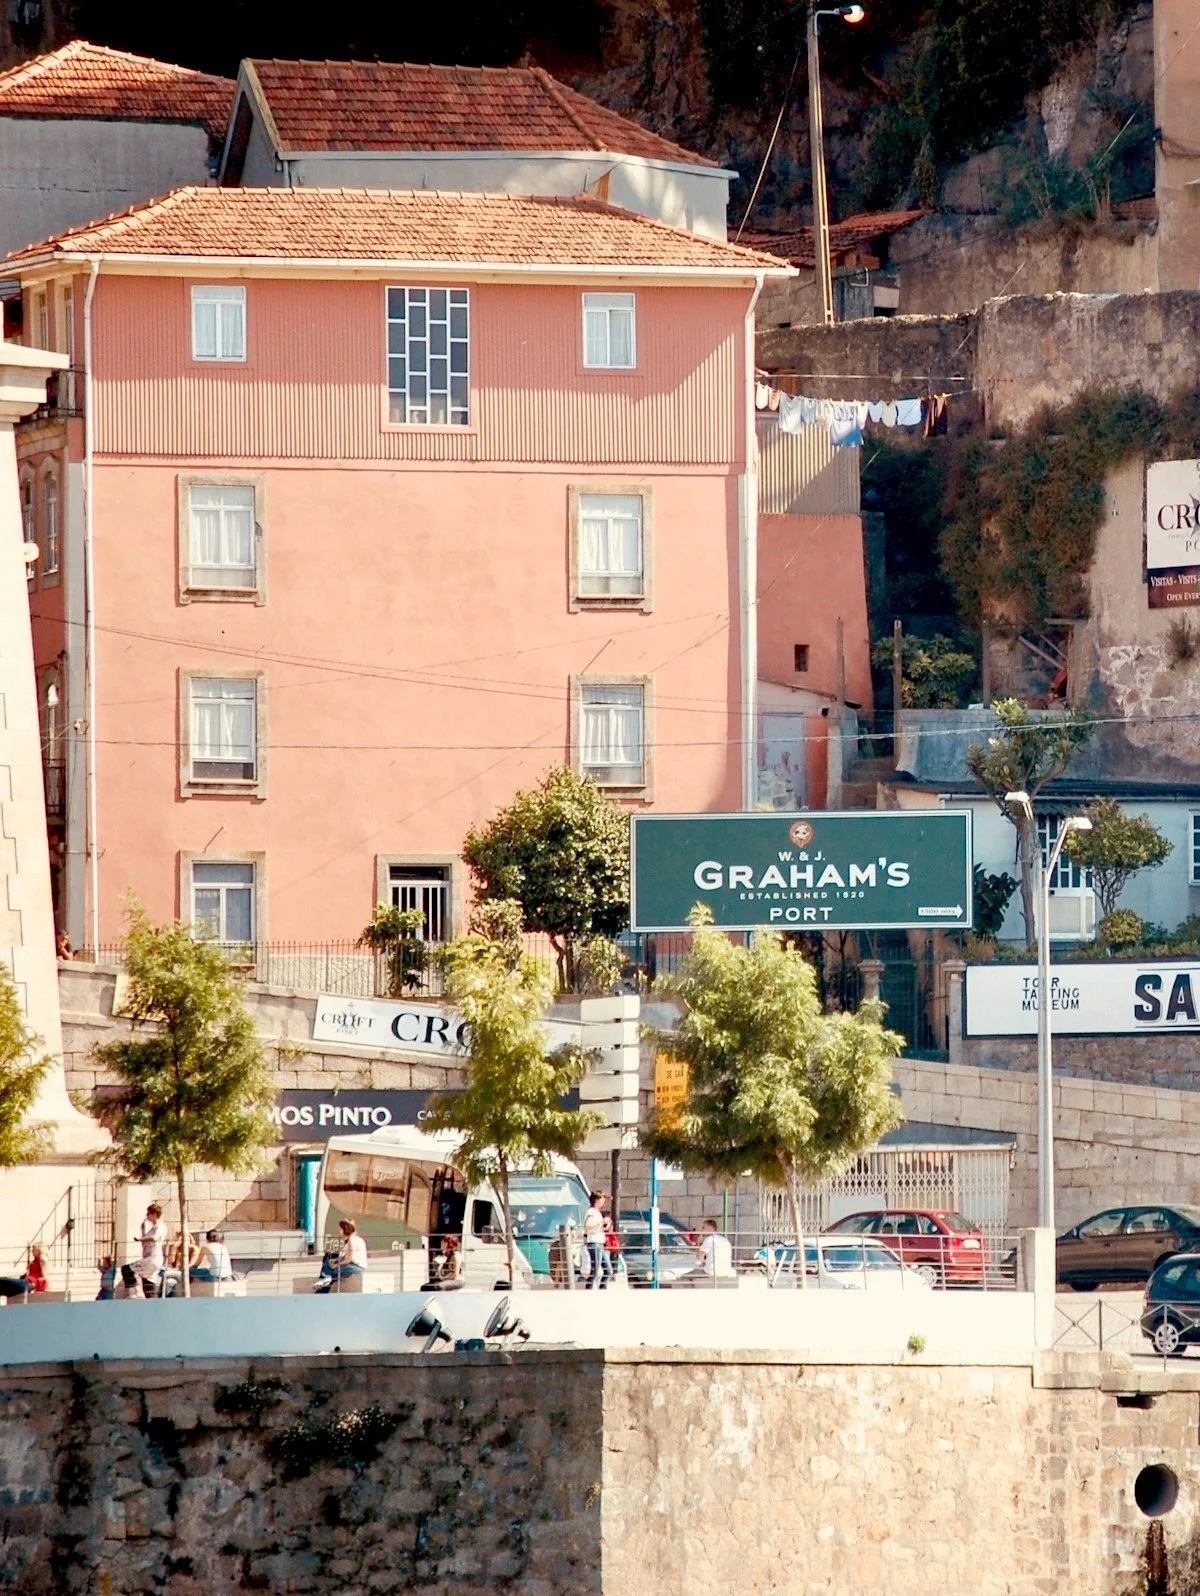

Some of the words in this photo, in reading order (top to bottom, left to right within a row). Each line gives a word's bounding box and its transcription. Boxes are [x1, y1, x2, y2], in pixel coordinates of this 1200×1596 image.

[778, 851, 794, 862] W.
[799, 852, 808, 861] &
[814, 851, 826, 862] J.
[693, 857, 910, 891] GRAHAM'S
[740, 892, 828, 900] ESTABLISHED
[836, 890, 865, 899] 1820
[769, 907, 833, 921] PORT
[1022, 977, 1060, 988] TOR
[1022, 988, 1080, 999] TATING
[1022, 999, 1079, 1011] MUEUM
[321, 1012, 376, 1028] CROFT
[318, 1103, 393, 1126] PINTO
